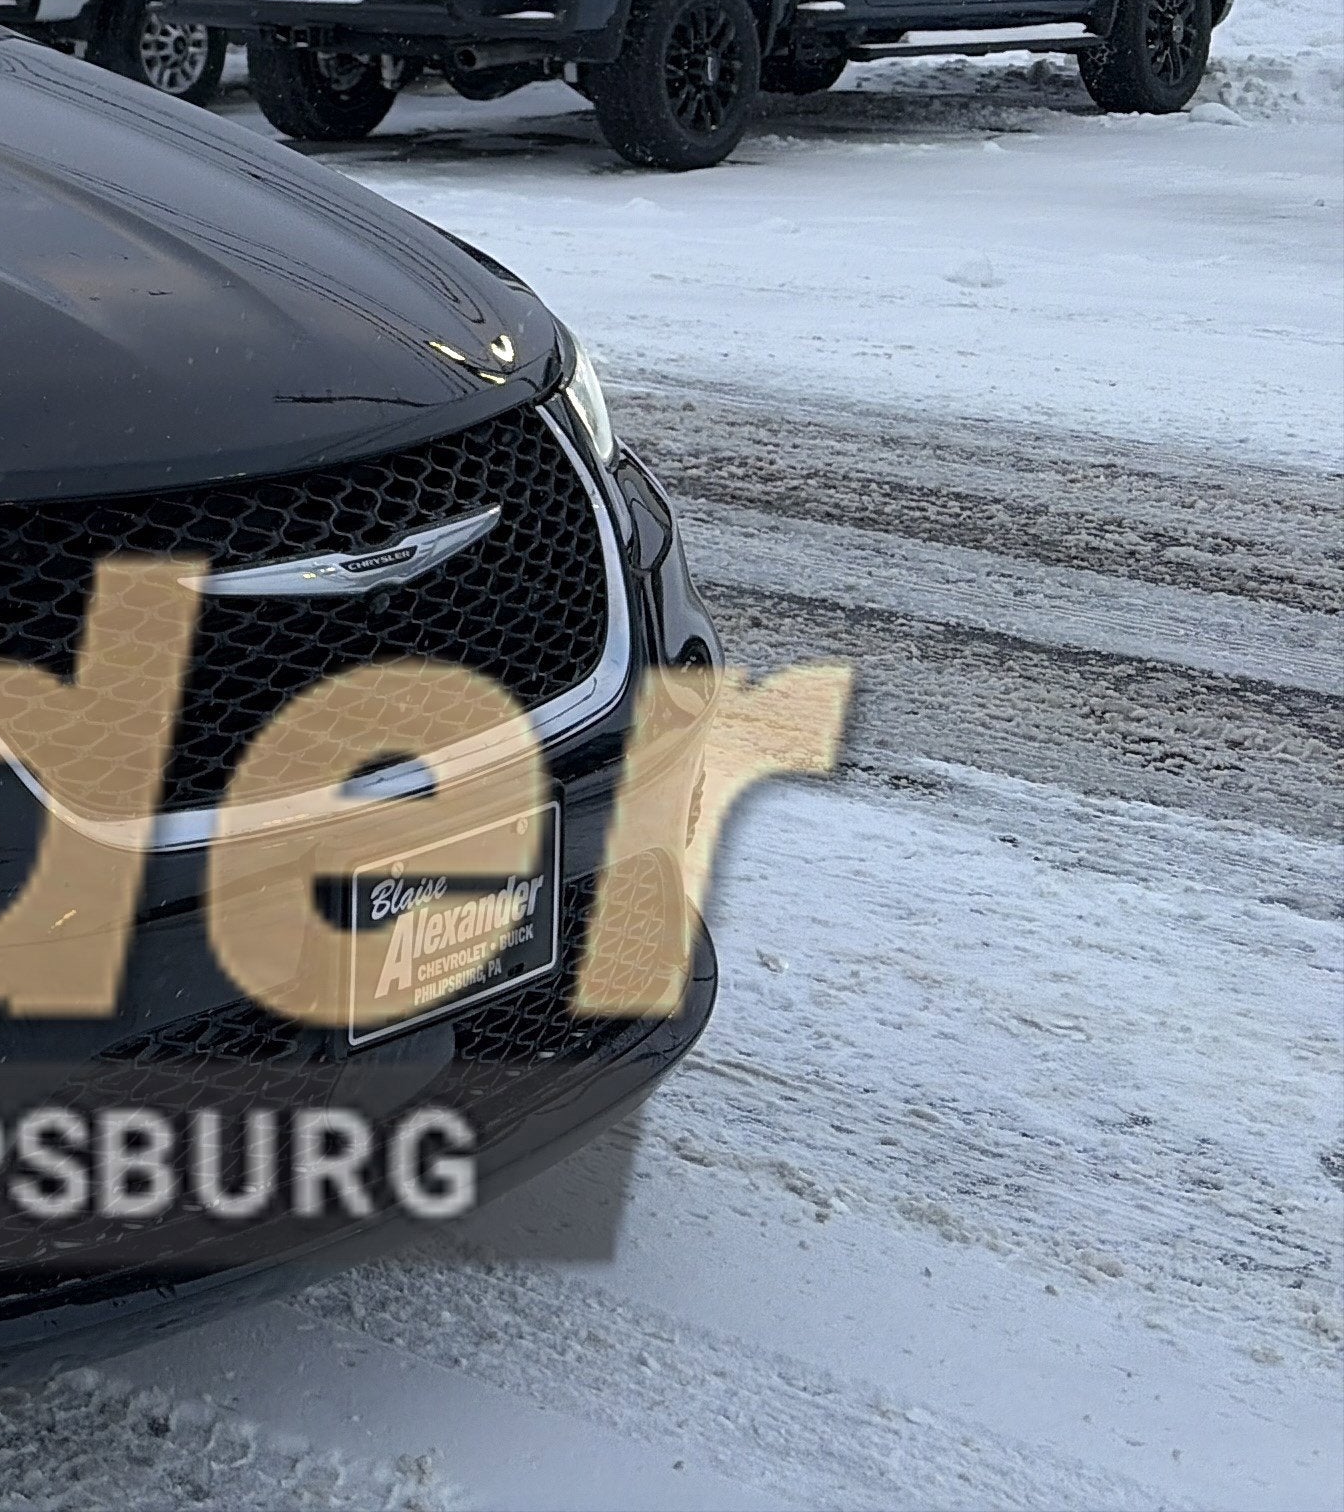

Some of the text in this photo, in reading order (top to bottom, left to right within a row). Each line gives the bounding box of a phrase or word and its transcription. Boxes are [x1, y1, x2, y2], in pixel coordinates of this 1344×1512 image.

[347, 550, 411, 571] CHRYSLER
[370, 875, 448, 921] Blaise
[374, 874, 544, 1000] Alexander
[417, 923, 534, 982] CHEVROLET BUICK
[488, 957, 502, 976] PA
